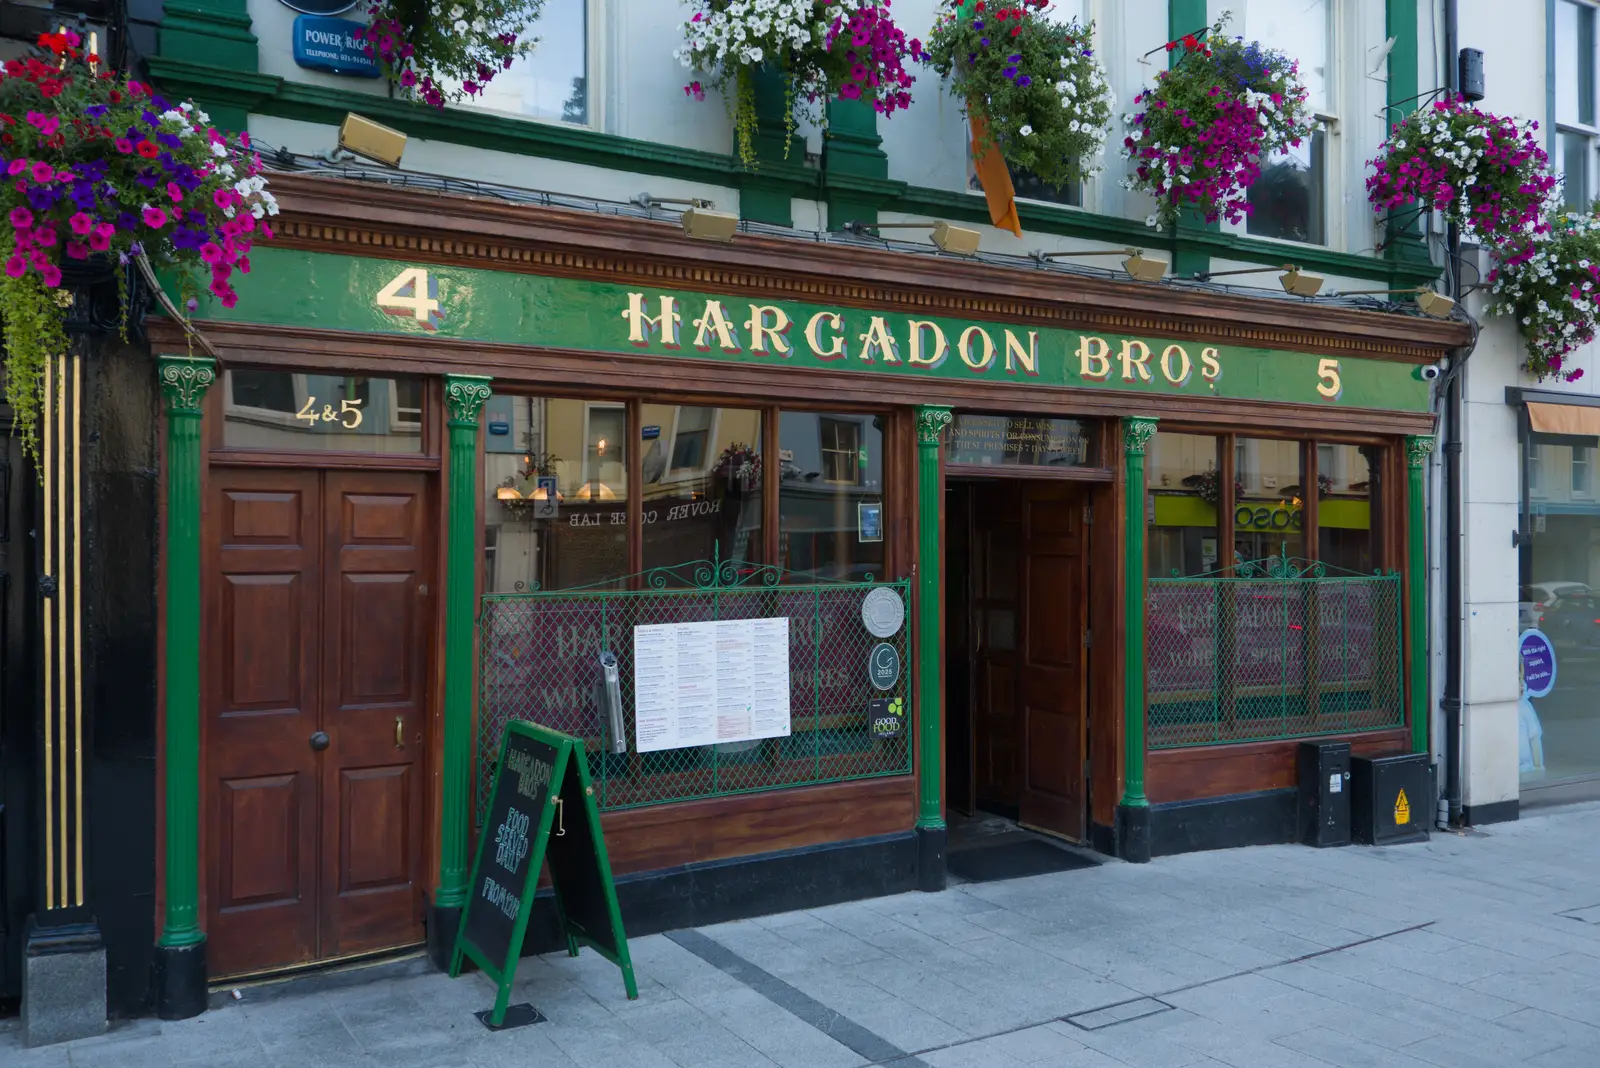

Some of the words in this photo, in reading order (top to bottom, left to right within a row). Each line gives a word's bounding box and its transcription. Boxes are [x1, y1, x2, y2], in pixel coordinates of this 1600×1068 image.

[305, 30, 342, 47] POWER
[376, 267, 442, 325] 4
[621, 291, 1038, 374] HARGADON
[1316, 358, 1341, 398] 5
[295, 396, 363, 429] 4&5
[949, 428, 967, 437] AND
[968, 429, 1000, 439] SPIRITS
[873, 722, 901, 733] FOOD
[875, 717, 897, 726] GOOD
[506, 806, 530, 837] FOOD
[494, 823, 529, 859] SERVED
[496, 842, 521, 875] DAILY
